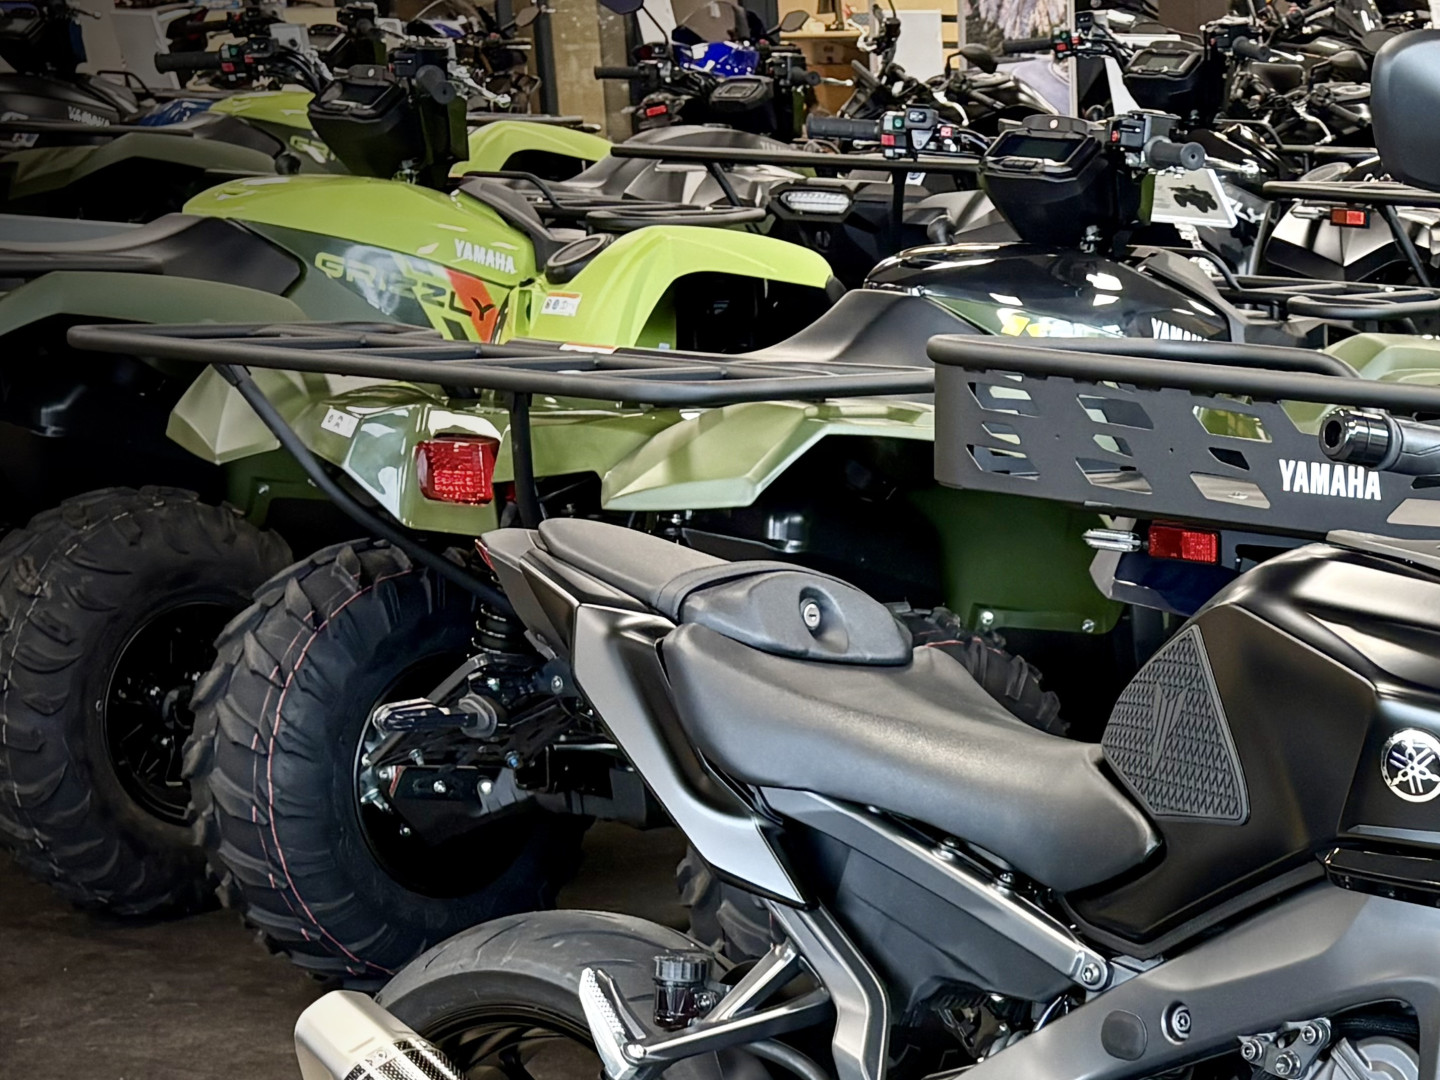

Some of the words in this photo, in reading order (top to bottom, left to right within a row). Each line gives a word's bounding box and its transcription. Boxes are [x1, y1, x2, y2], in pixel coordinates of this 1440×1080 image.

[454, 238, 517, 274] YAMAHA
[315, 252, 496, 321] GRIZZLY
[1279, 459, 1382, 501] YAMAHA
